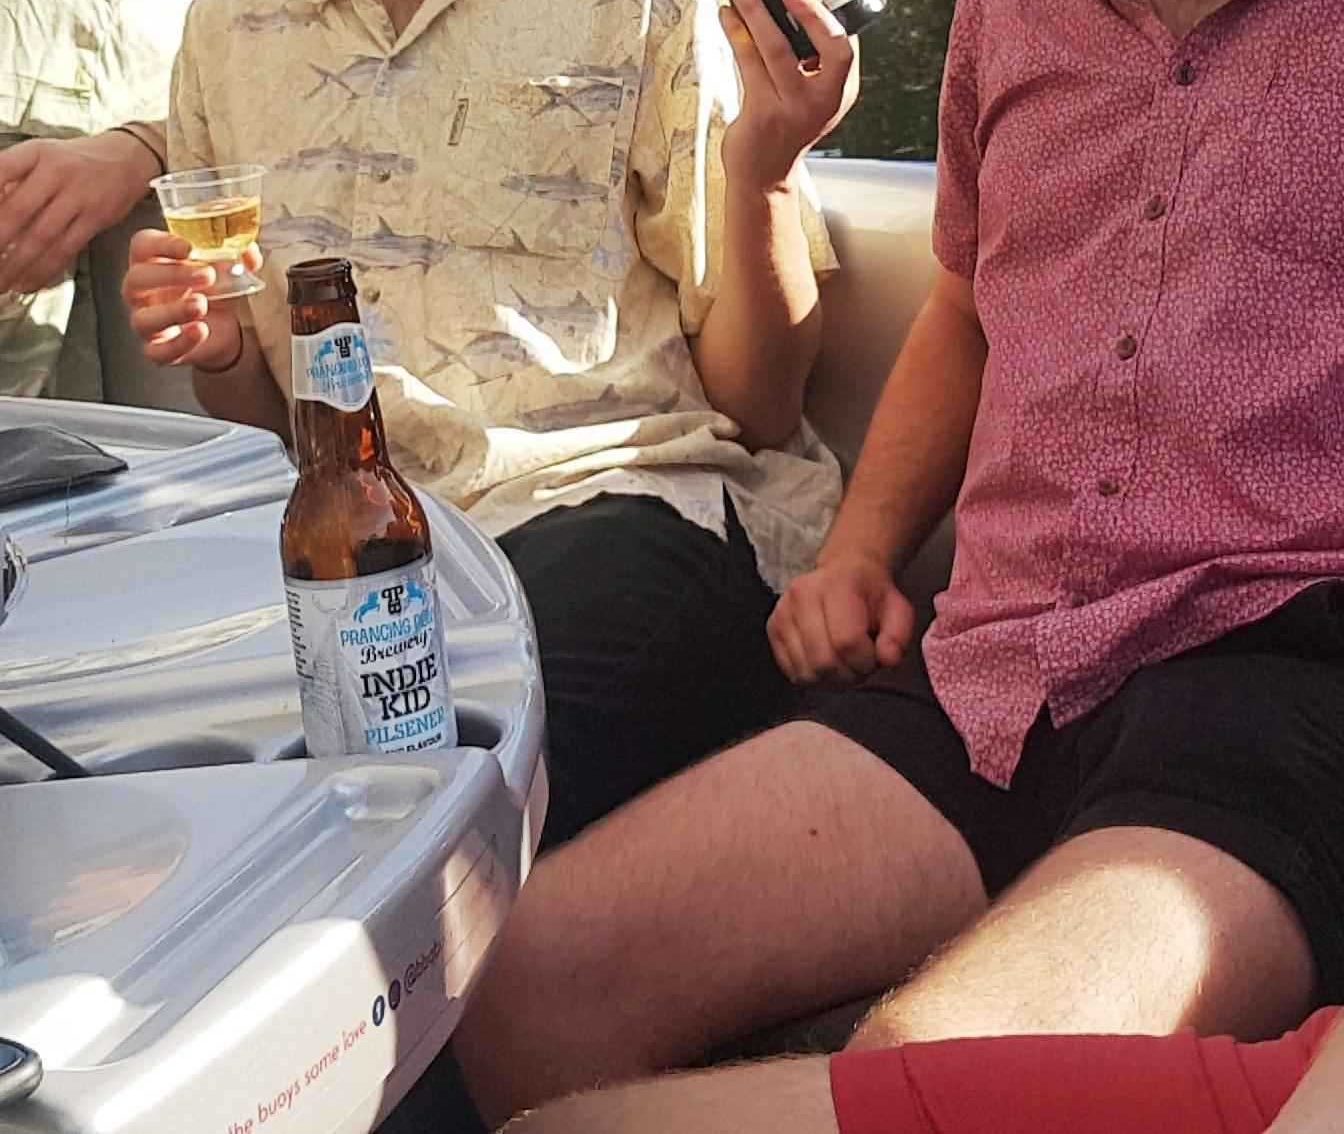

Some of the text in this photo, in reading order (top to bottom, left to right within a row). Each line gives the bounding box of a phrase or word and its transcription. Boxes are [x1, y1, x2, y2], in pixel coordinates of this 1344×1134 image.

[339, 617, 411, 648] PRANCING
[359, 630, 429, 665] Brewery
[359, 652, 437, 699] INDIE
[378, 684, 432, 722] KID
[364, 705, 446, 746] PILSENER
[257, 1079, 301, 1125] buoys
[304, 1045, 340, 1087] some
[341, 1019, 368, 1053] love
